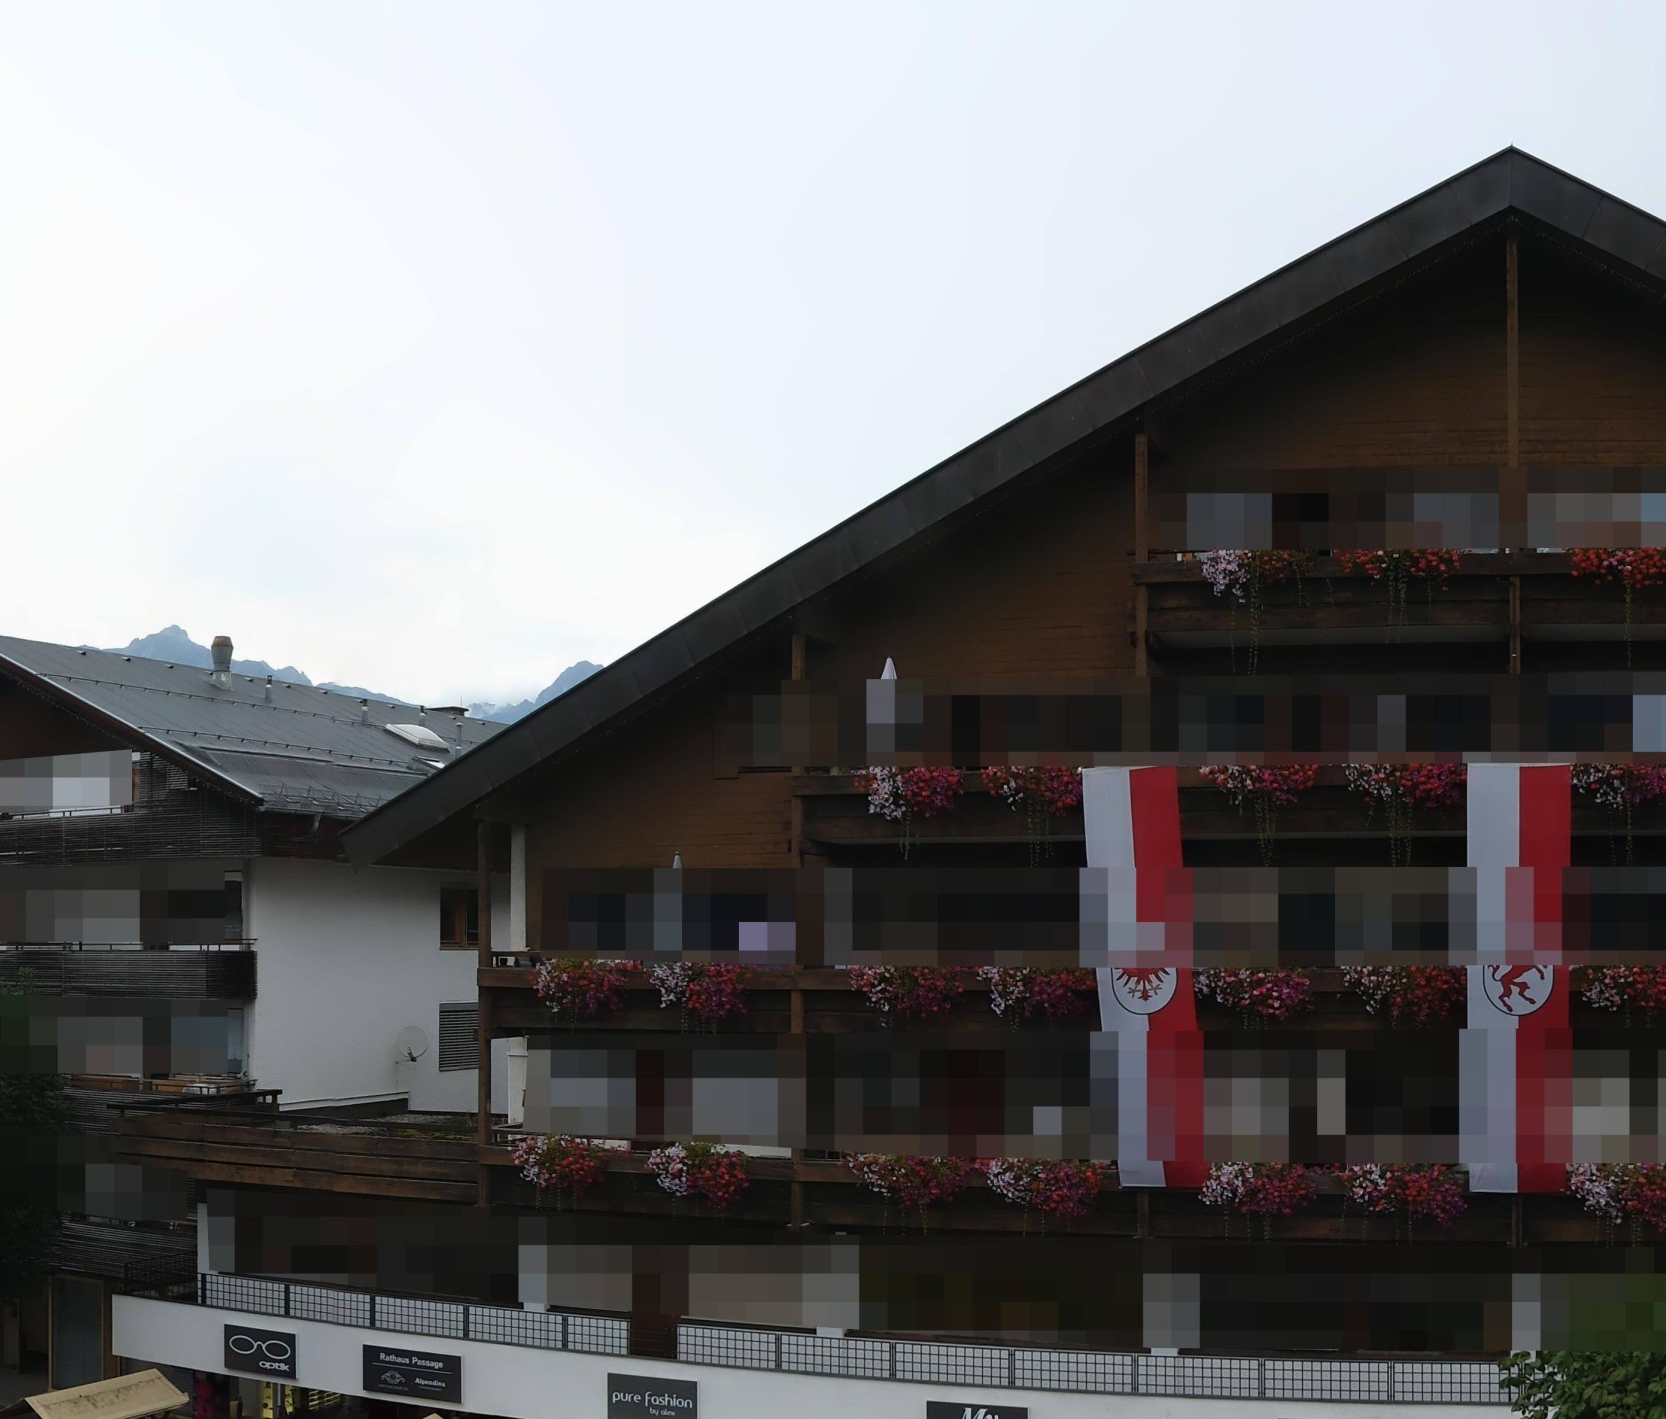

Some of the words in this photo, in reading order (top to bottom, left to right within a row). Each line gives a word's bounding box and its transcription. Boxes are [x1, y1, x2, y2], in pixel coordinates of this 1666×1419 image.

[259, 1361, 290, 1372] optik
[380, 1352, 410, 1364] Rathaus
[412, 1356, 443, 1369] Passage
[612, 1391, 642, 1406] pure
[645, 1392, 693, 1409] fashion
[650, 1407, 659, 1417] by
[661, 1409, 676, 1417] alex
